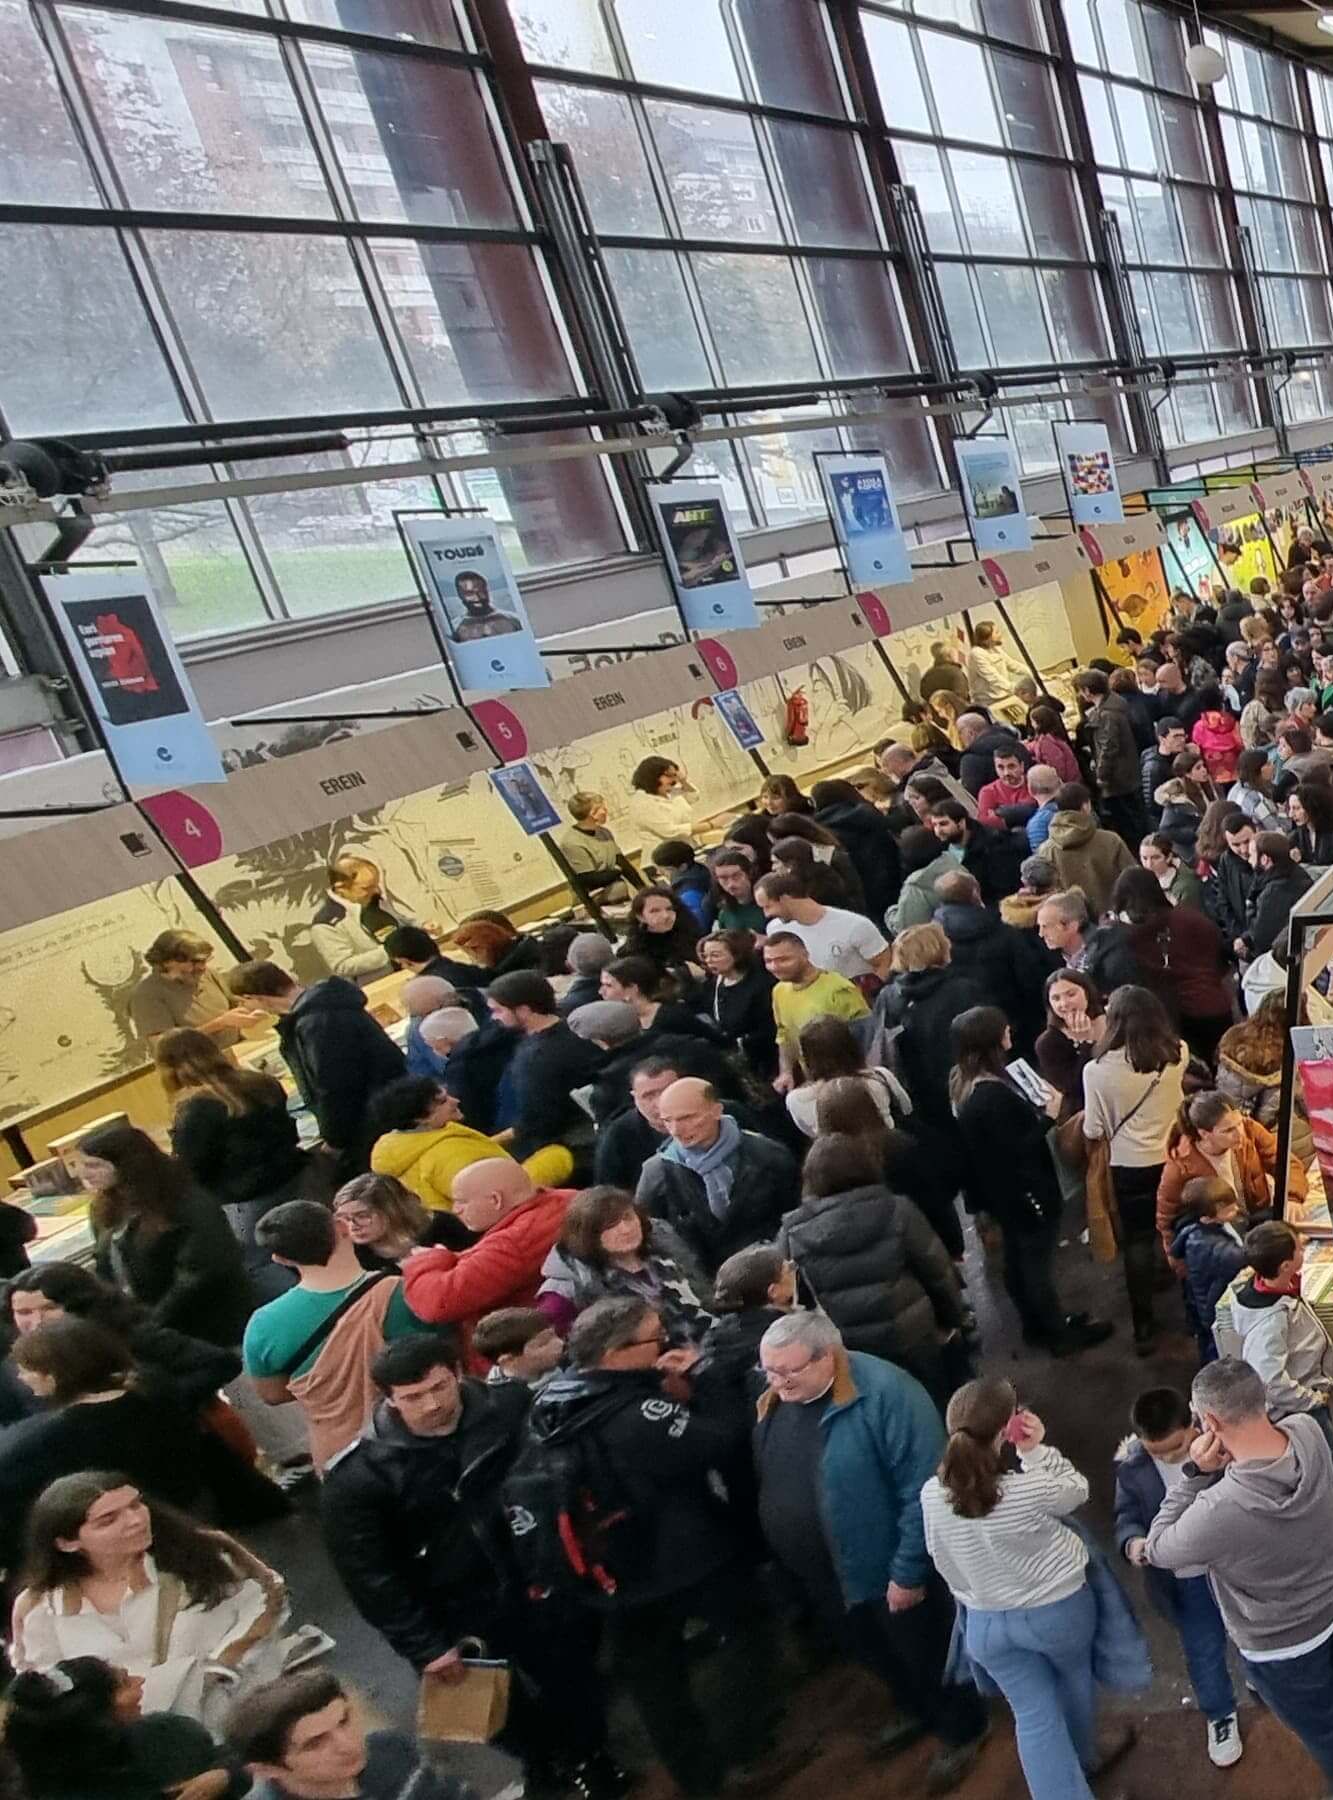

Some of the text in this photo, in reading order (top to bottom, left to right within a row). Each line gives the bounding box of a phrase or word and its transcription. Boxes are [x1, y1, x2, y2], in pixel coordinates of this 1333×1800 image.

[716, 656, 728, 672] 6
[592, 691, 626, 711] EREIN
[498, 721, 513, 740] 5
[319, 771, 367, 796] EREIN
[185, 818, 201, 838] 4
